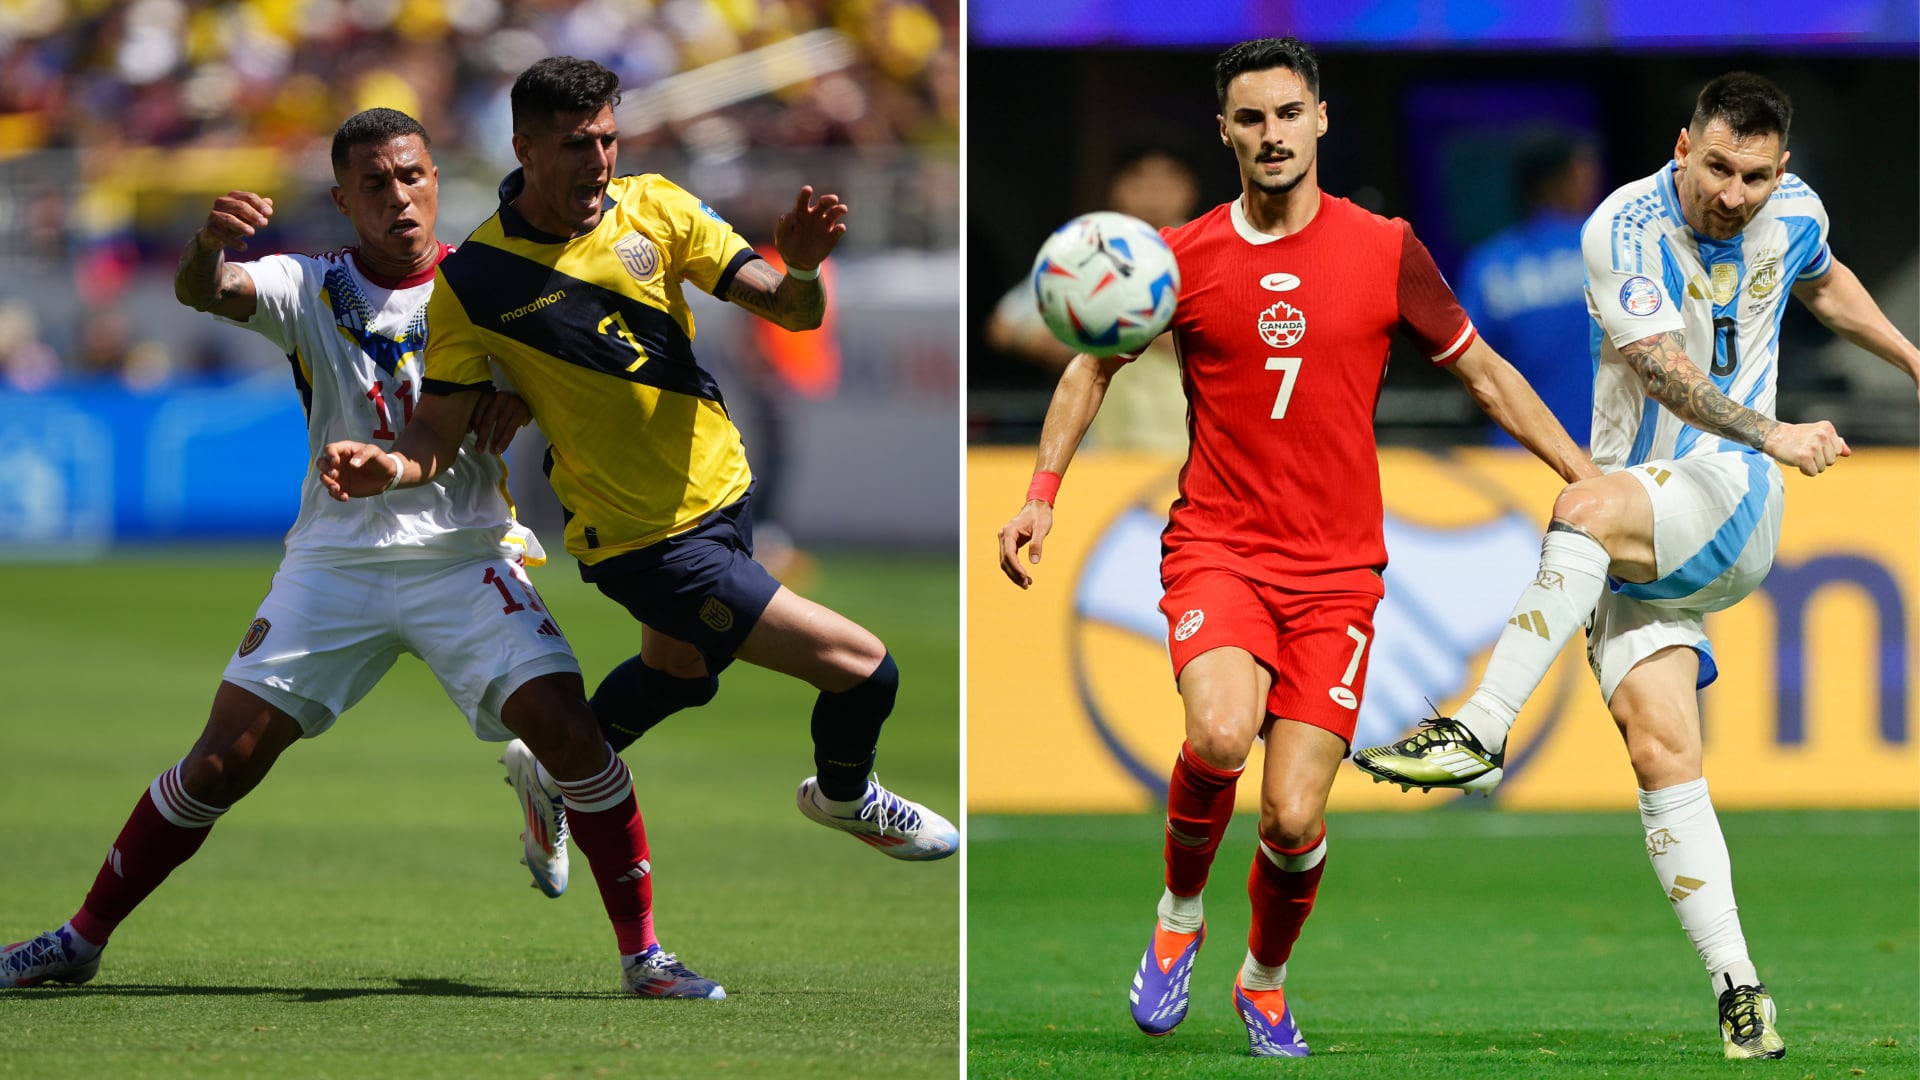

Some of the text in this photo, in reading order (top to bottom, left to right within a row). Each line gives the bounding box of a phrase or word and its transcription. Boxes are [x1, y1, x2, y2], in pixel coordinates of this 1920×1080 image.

[500, 289, 567, 323] marathon
[1260, 322, 1303, 330] CANADA
[1264, 357, 1302, 420] 7
[1341, 624, 1368, 687] 7
